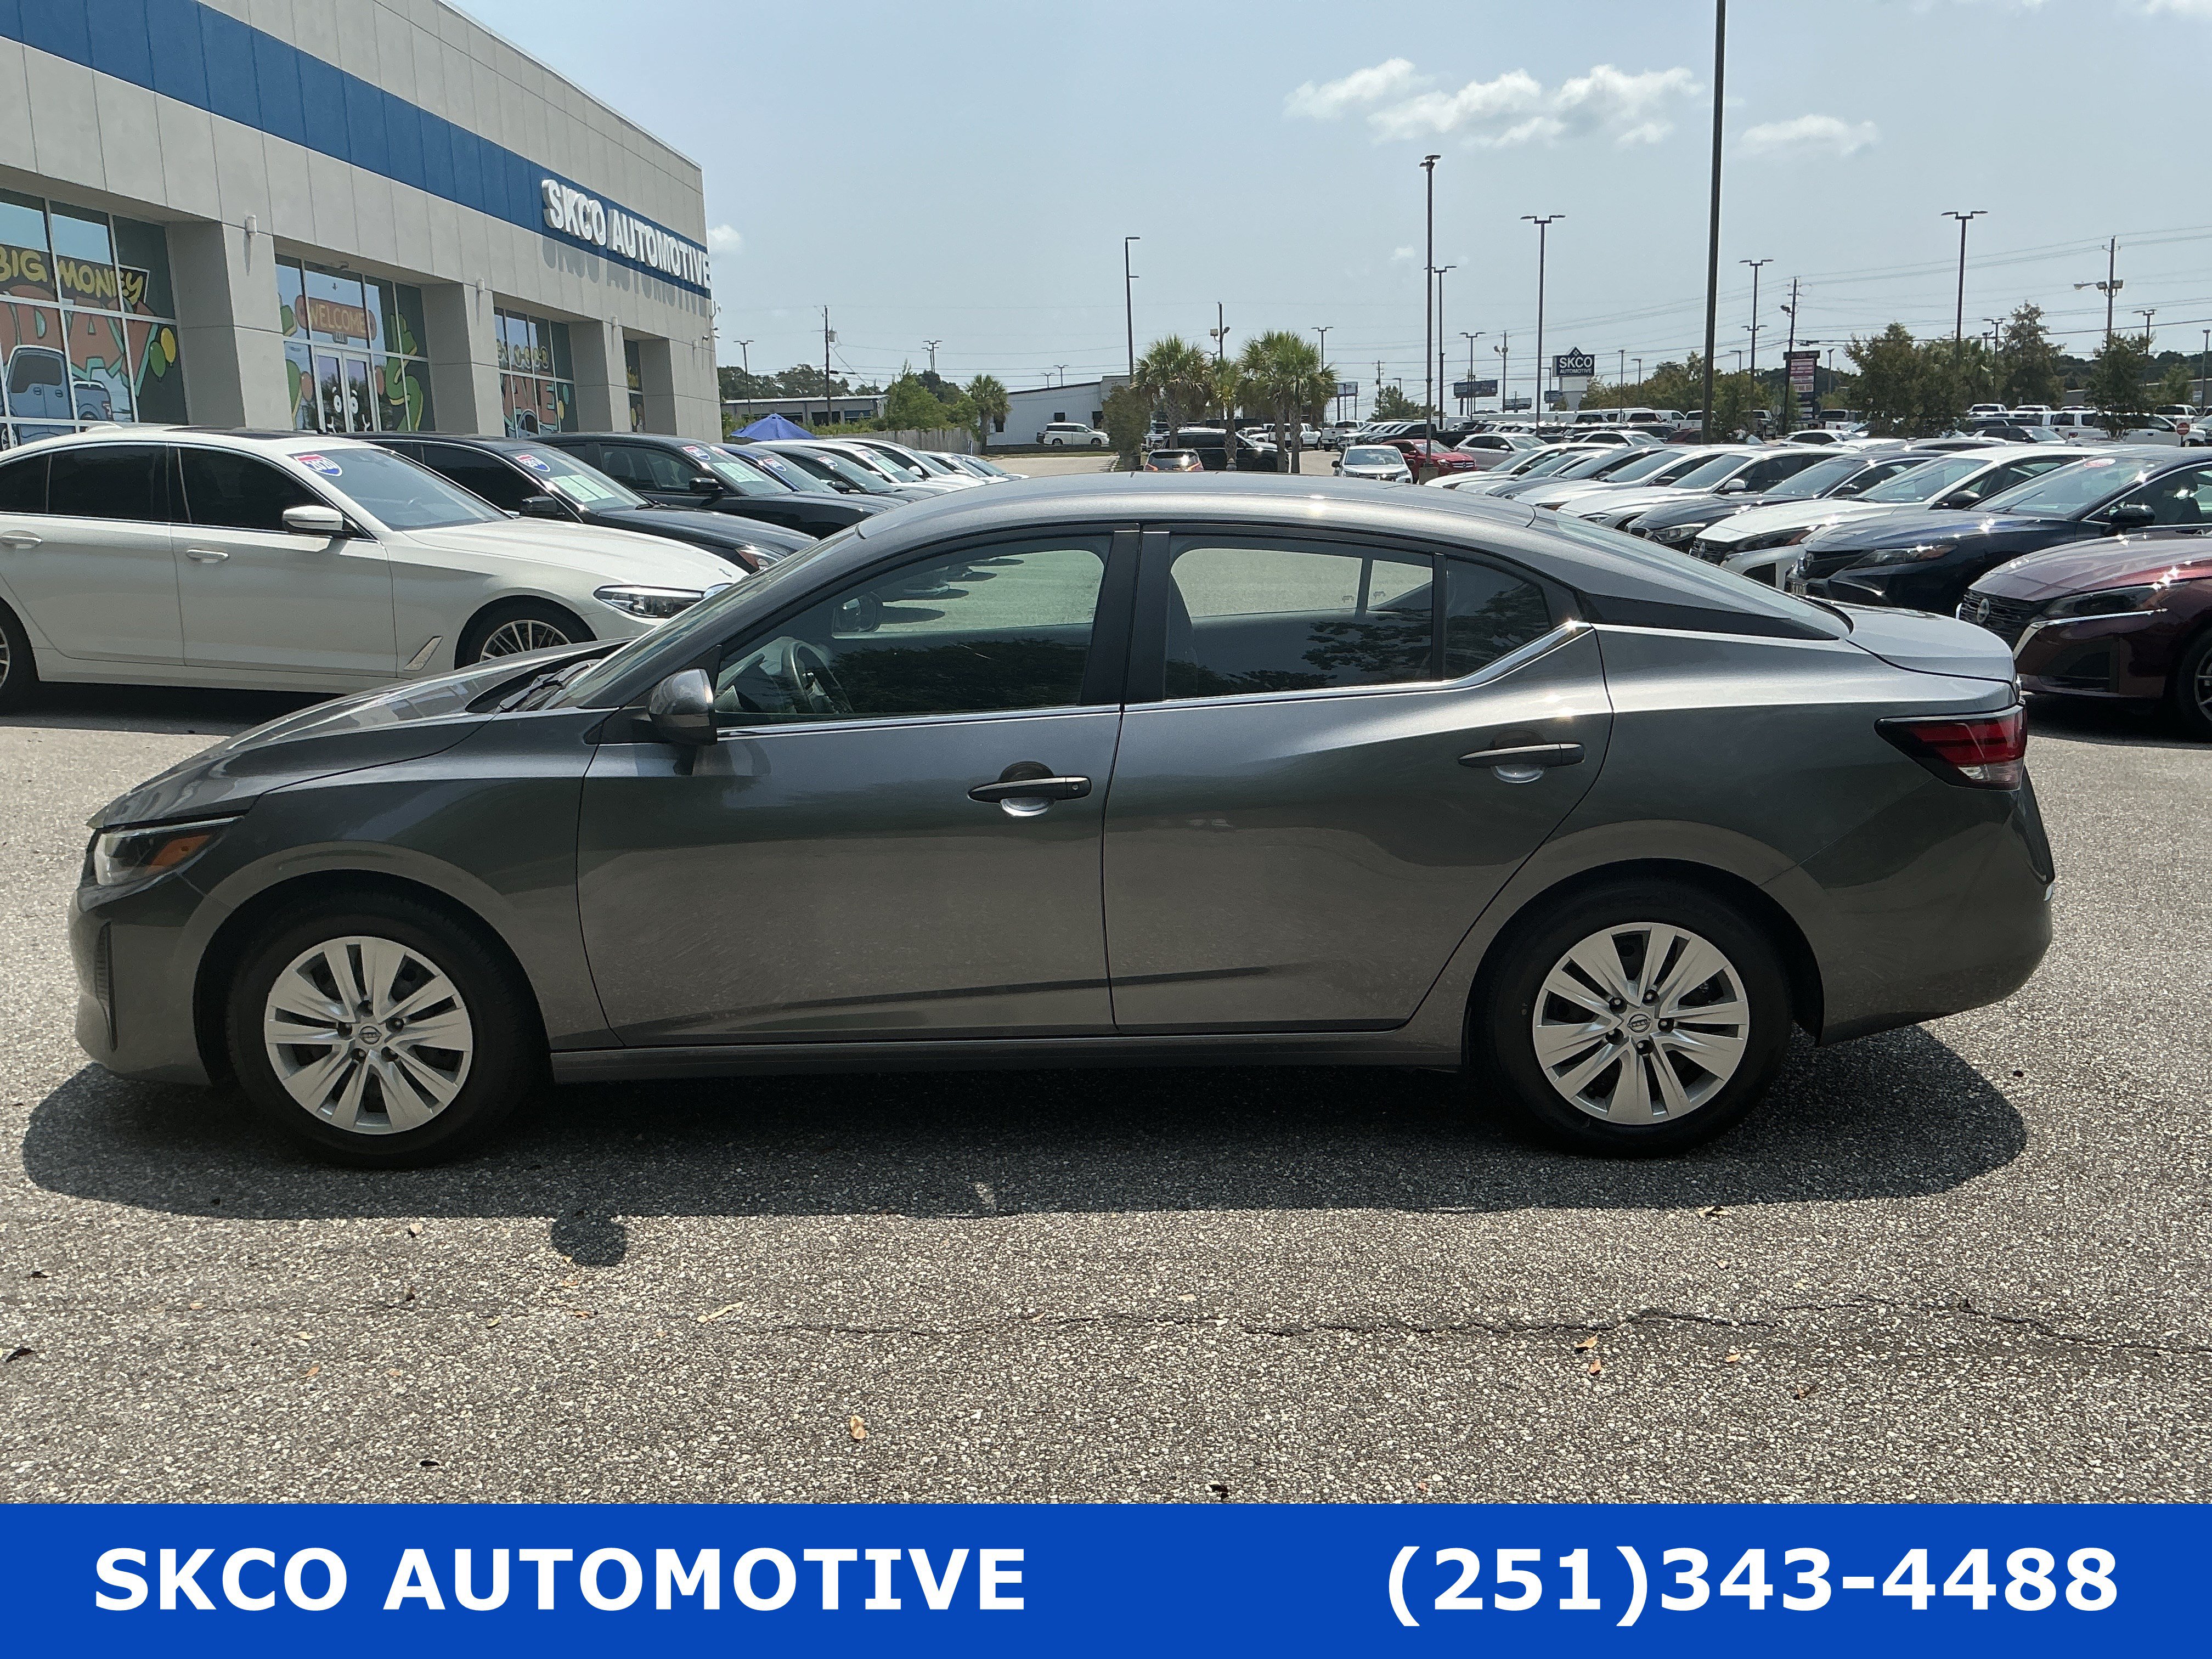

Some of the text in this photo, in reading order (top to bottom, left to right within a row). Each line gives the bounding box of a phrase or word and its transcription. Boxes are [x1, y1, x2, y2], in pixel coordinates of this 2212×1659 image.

[541, 179, 712, 289] SKCO AUTOMOTIVE
[309, 303, 366, 335] WELCOME
[1559, 356, 1593, 368] SKCO
